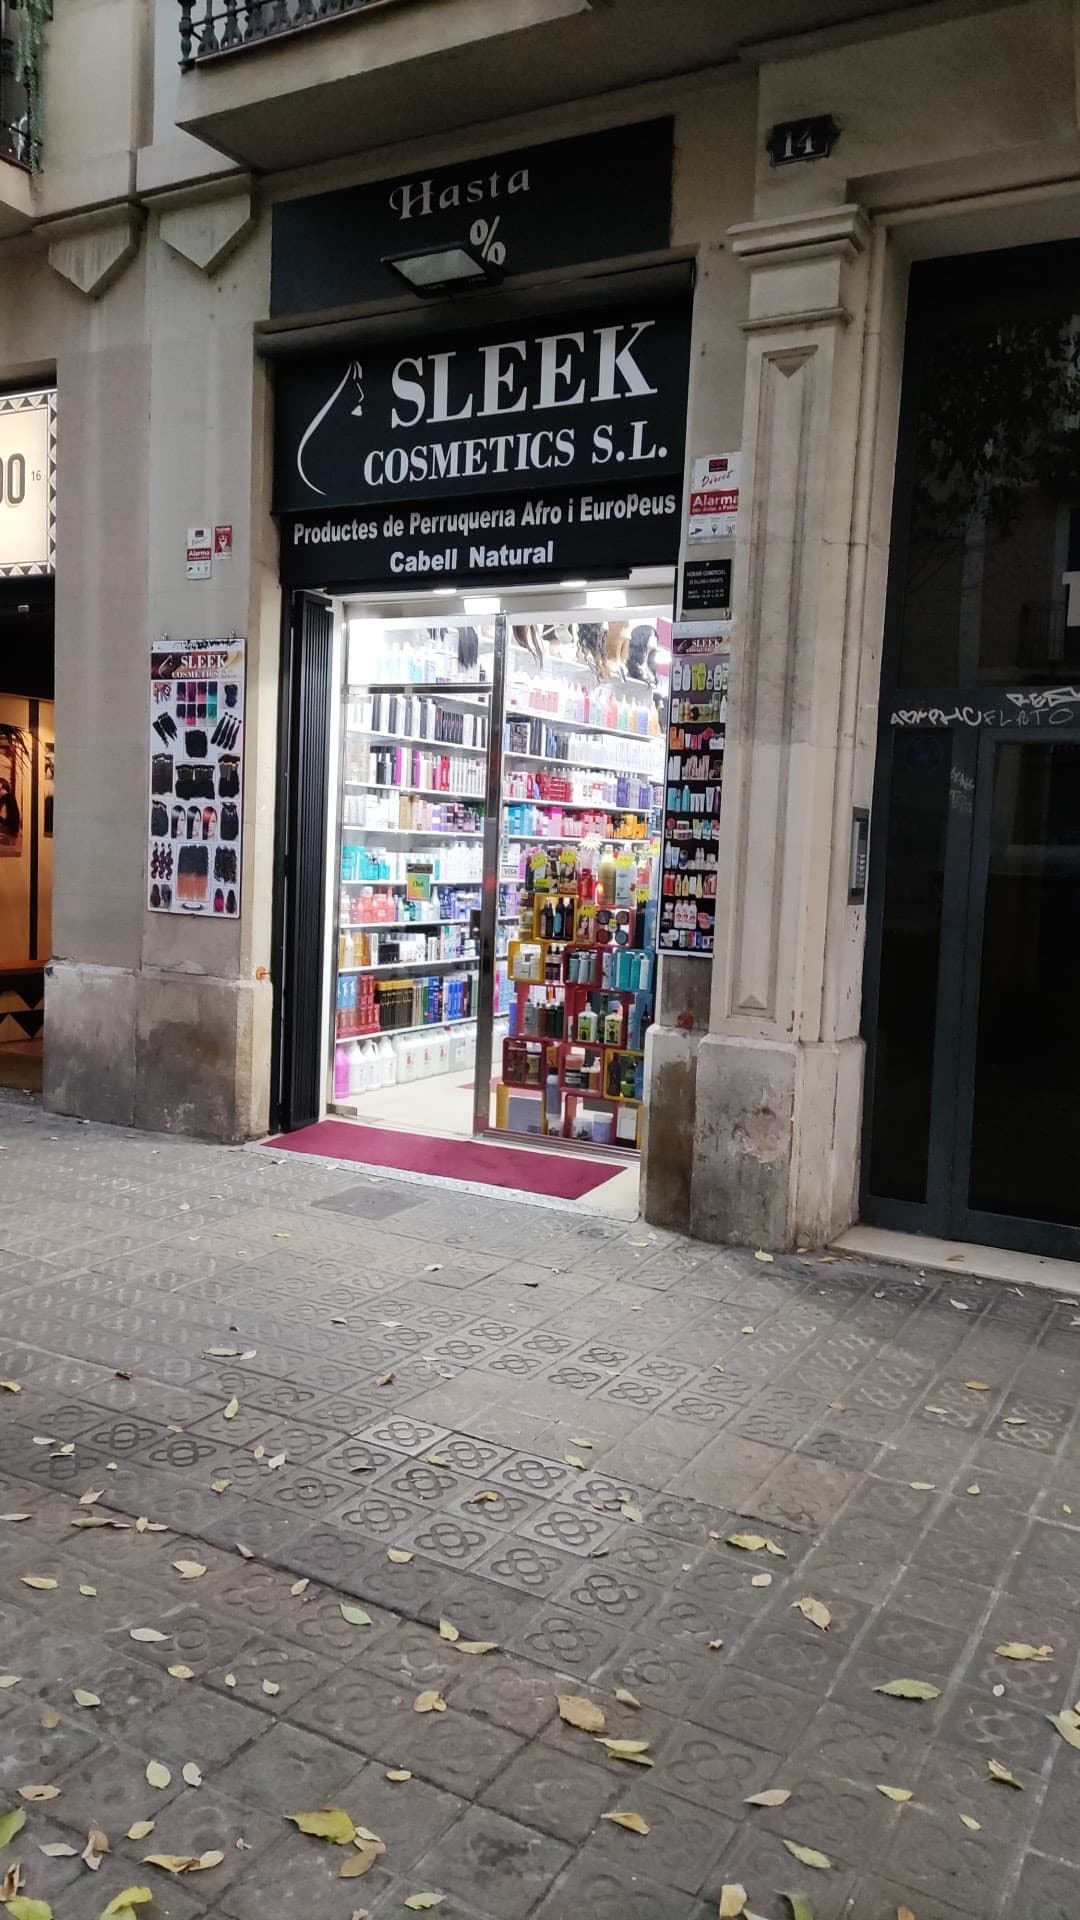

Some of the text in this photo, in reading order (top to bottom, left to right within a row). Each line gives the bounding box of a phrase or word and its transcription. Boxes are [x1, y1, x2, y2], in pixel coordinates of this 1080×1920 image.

[783, 131, 815, 158] 14
[389, 167, 531, 220] Hasta
[391, 319, 659, 430] SLEEK
[363, 420, 669, 487] COSMETICS S.L.
[31, 470, 42, 482] 16
[293, 517, 378, 546] Productes
[383, 514, 405, 538] de
[409, 508, 516, 537] Perruqueria
[520, 500, 563, 527] Afro
[567, 502, 575, 524] i
[389, 540, 555, 574] Cabell Natural
[181, 654, 227, 669] SLEEK
